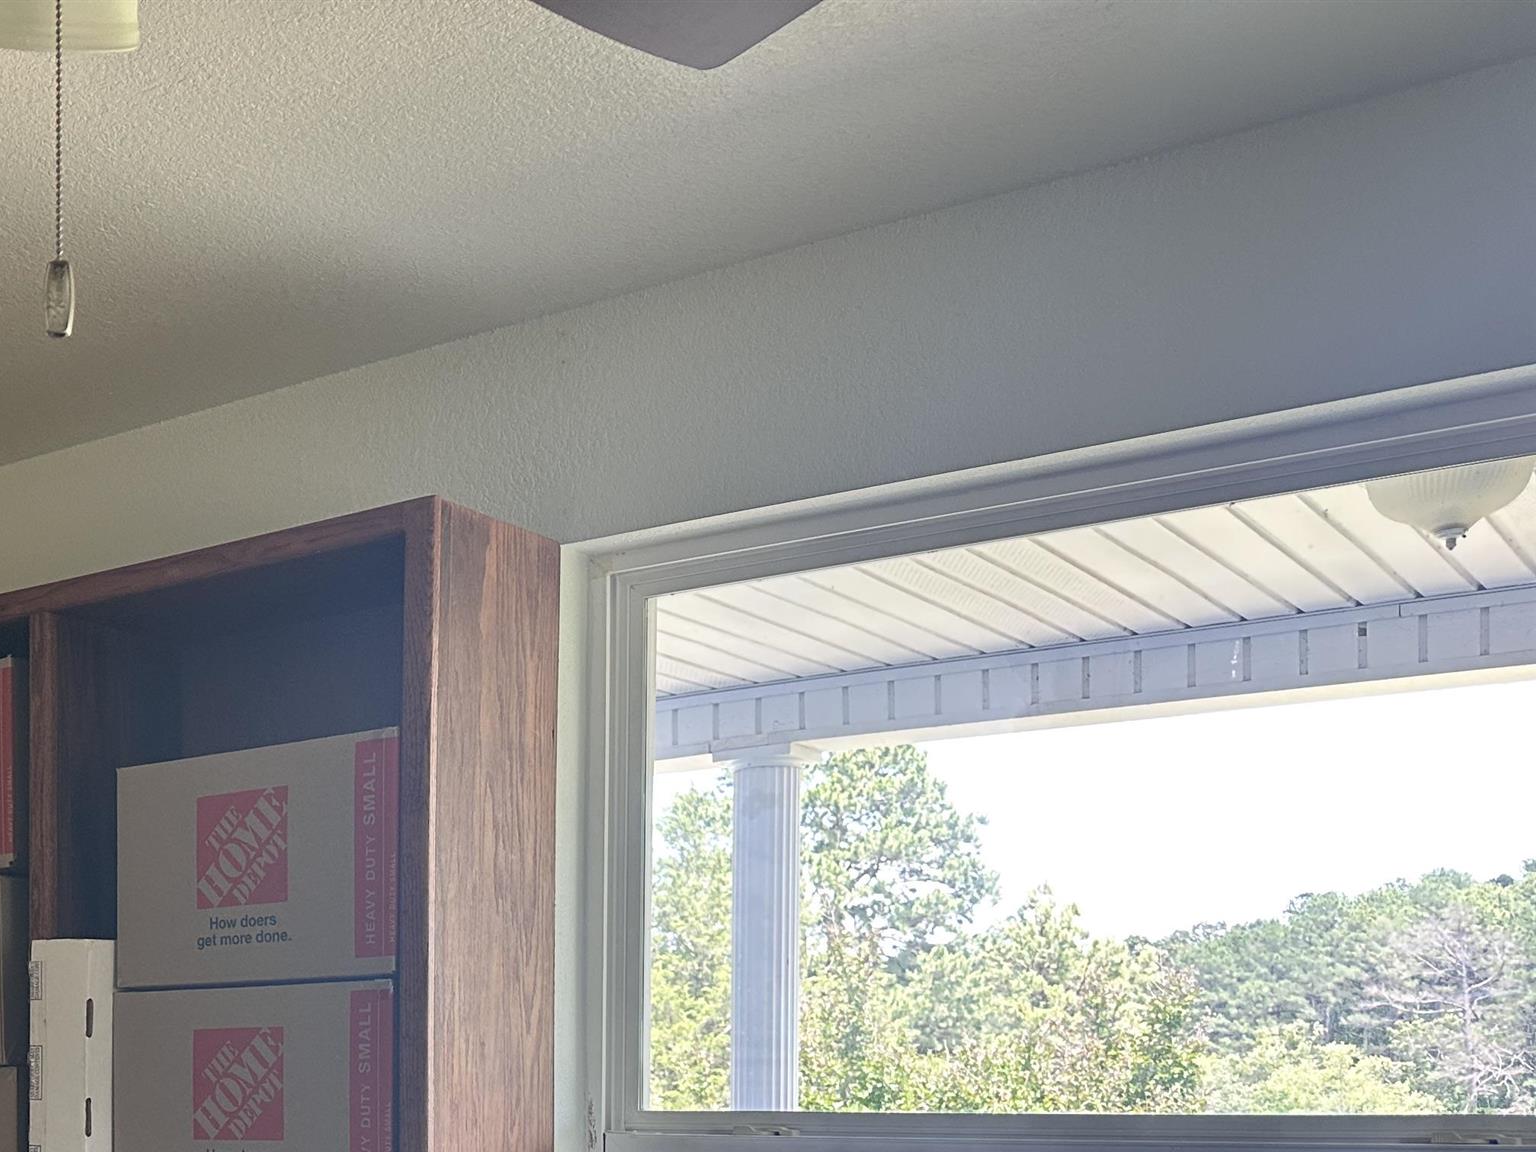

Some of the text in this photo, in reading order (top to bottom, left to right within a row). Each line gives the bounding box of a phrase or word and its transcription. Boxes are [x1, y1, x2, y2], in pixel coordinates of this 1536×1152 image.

[197, 787, 288, 907] HOME
[205, 805, 241, 850] THE
[363, 752, 377, 945] HEAVY DUTY SMALL
[232, 829, 288, 905] DEPOT
[197, 929, 292, 950] get more done.
[209, 913, 278, 931] How doers
[201, 1040, 238, 1083] THE
[358, 1002, 372, 1074] SMALL
[193, 1027, 283, 1139] HOME
[228, 1070, 283, 1141] DEPOT
[361, 1086, 372, 1130] DUTY
